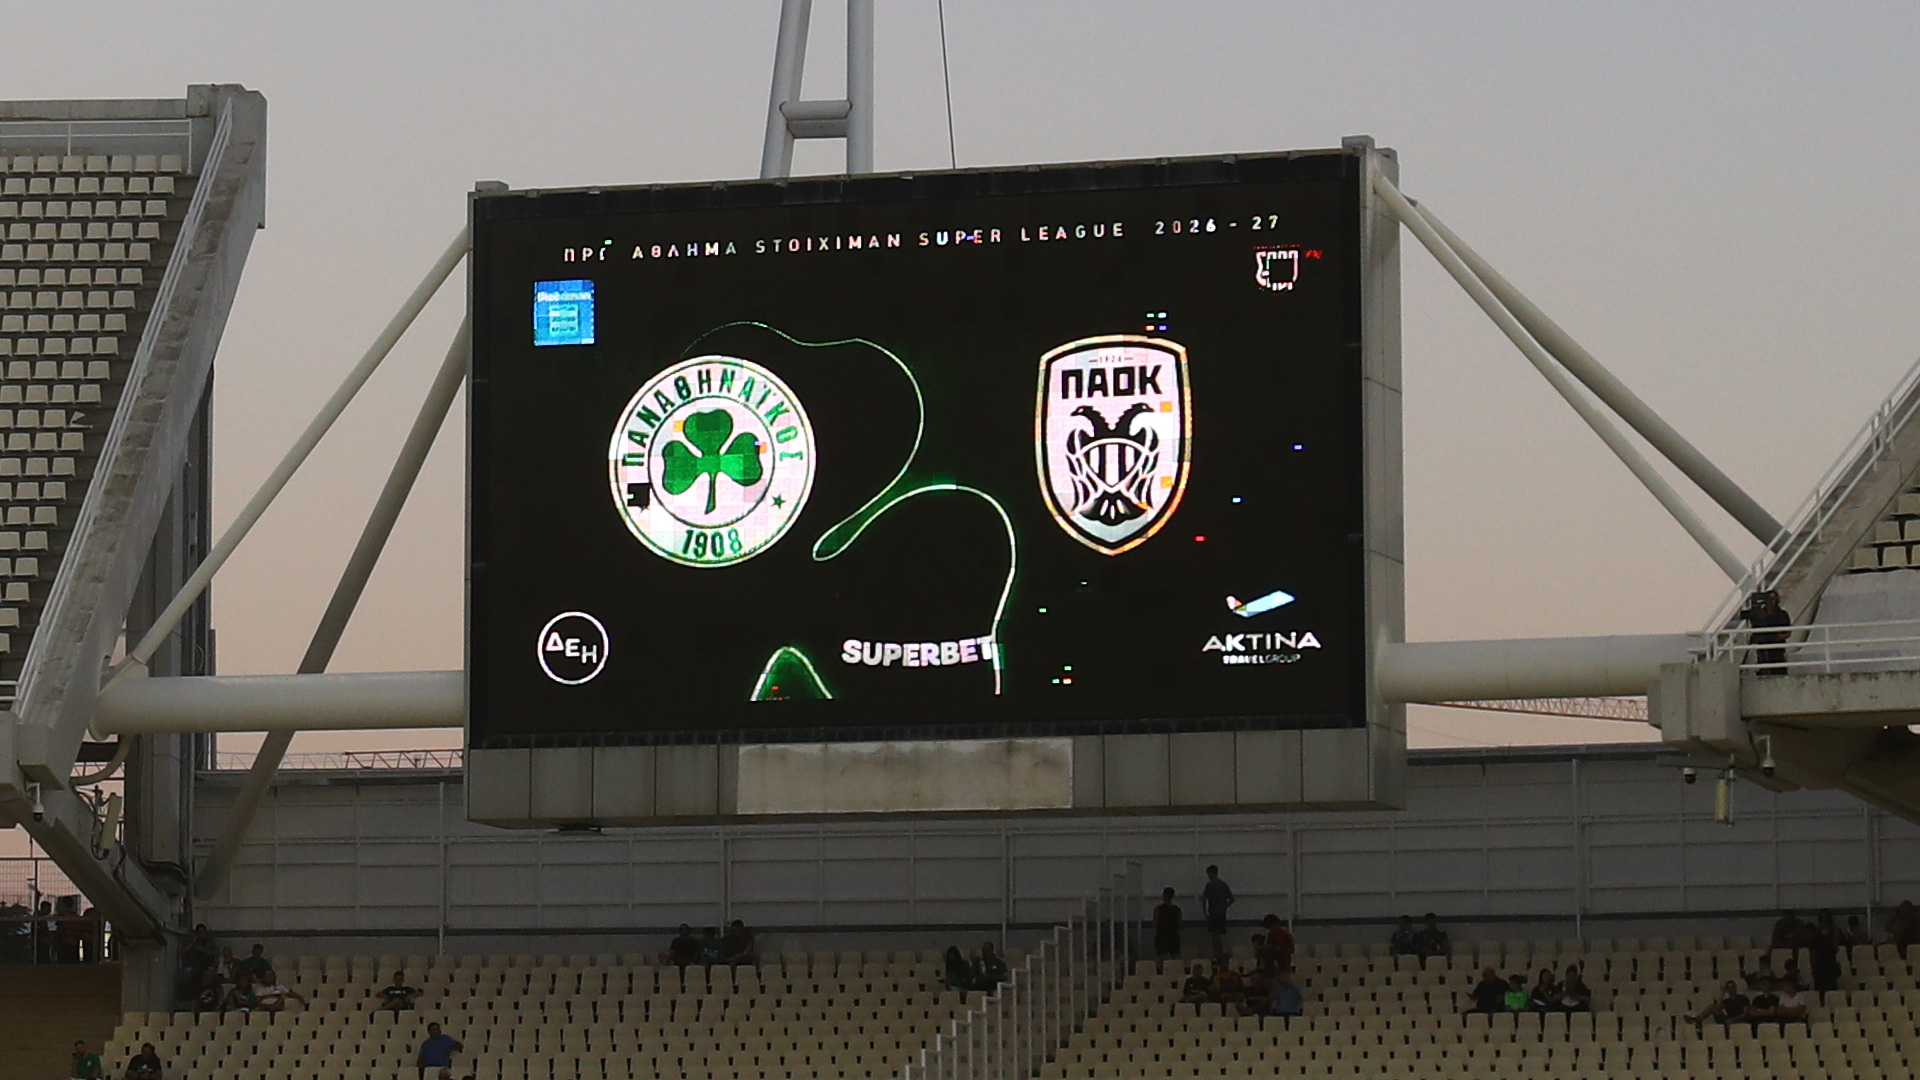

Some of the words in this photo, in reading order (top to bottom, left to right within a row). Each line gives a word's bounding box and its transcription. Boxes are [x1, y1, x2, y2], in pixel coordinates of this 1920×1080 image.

[755, 233, 901, 254] STOIXIMAN
[918, 228, 1001, 247] SUPER
[1020, 222, 1124, 242] LEAGUE
[1154, 218, 1217, 235] 2026
[1251, 214, 1279, 230] 27
[1061, 364, 1162, 400] ΠΑΟΚ
[682, 527, 742, 559] 1908
[545, 631, 597, 664] ΔΕΗ
[841, 634, 997, 668] SUPERBET
[1201, 631, 1322, 652] AKTINA
